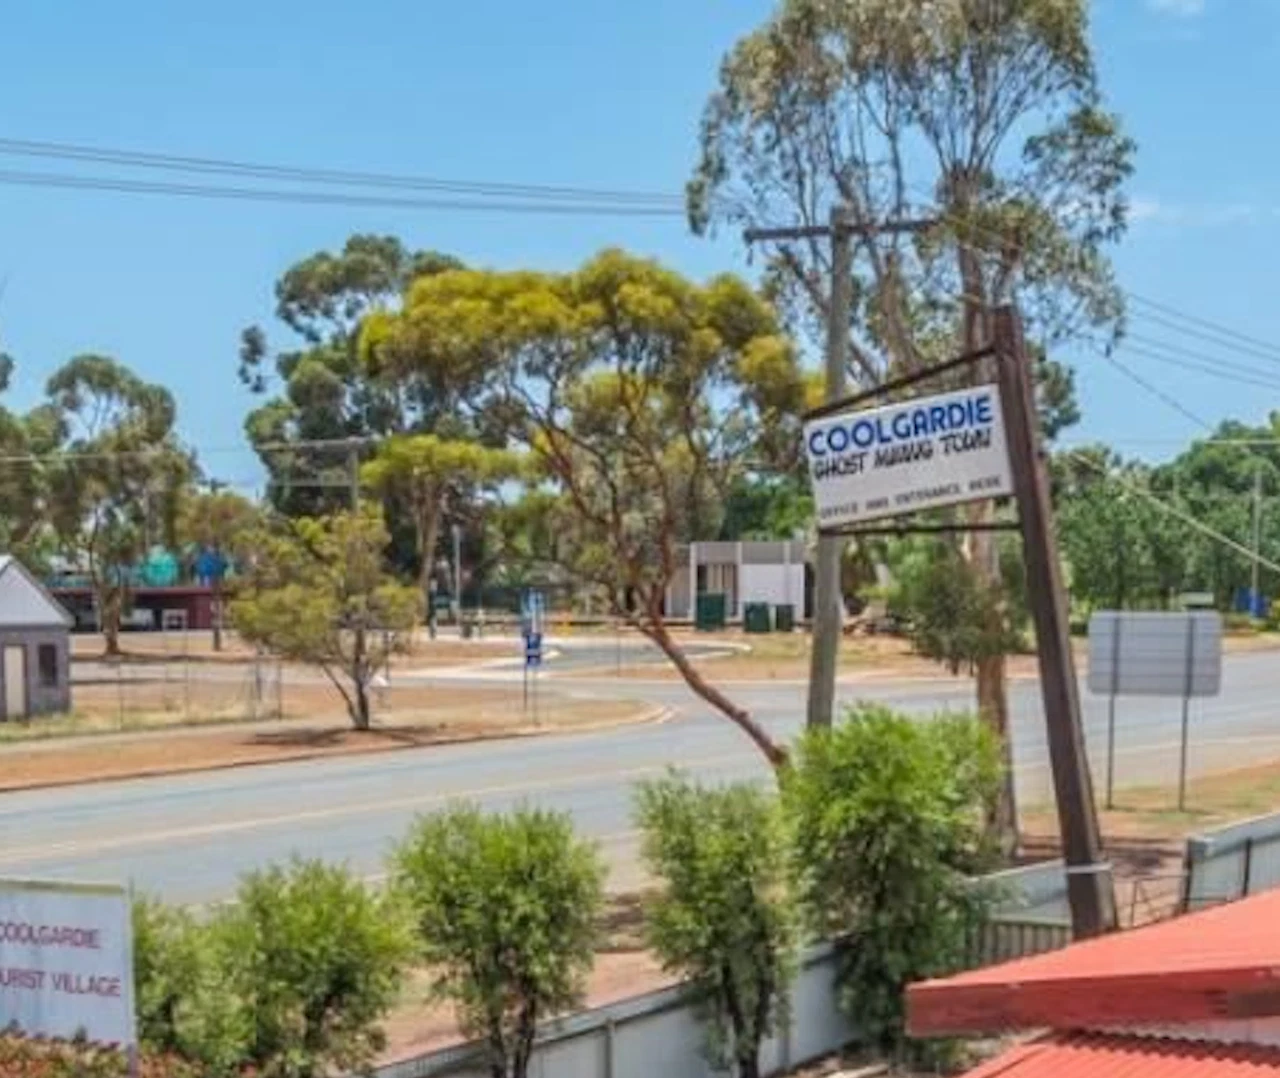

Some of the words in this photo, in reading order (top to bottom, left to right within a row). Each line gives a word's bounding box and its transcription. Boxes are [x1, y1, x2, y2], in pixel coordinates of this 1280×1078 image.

[810, 396, 993, 455] COOLGARDIE
[814, 452, 866, 481] GHOST
[874, 441, 934, 468] MINING
[939, 428, 991, 455] TOWN
[51, 972, 121, 997] VILLAGE
